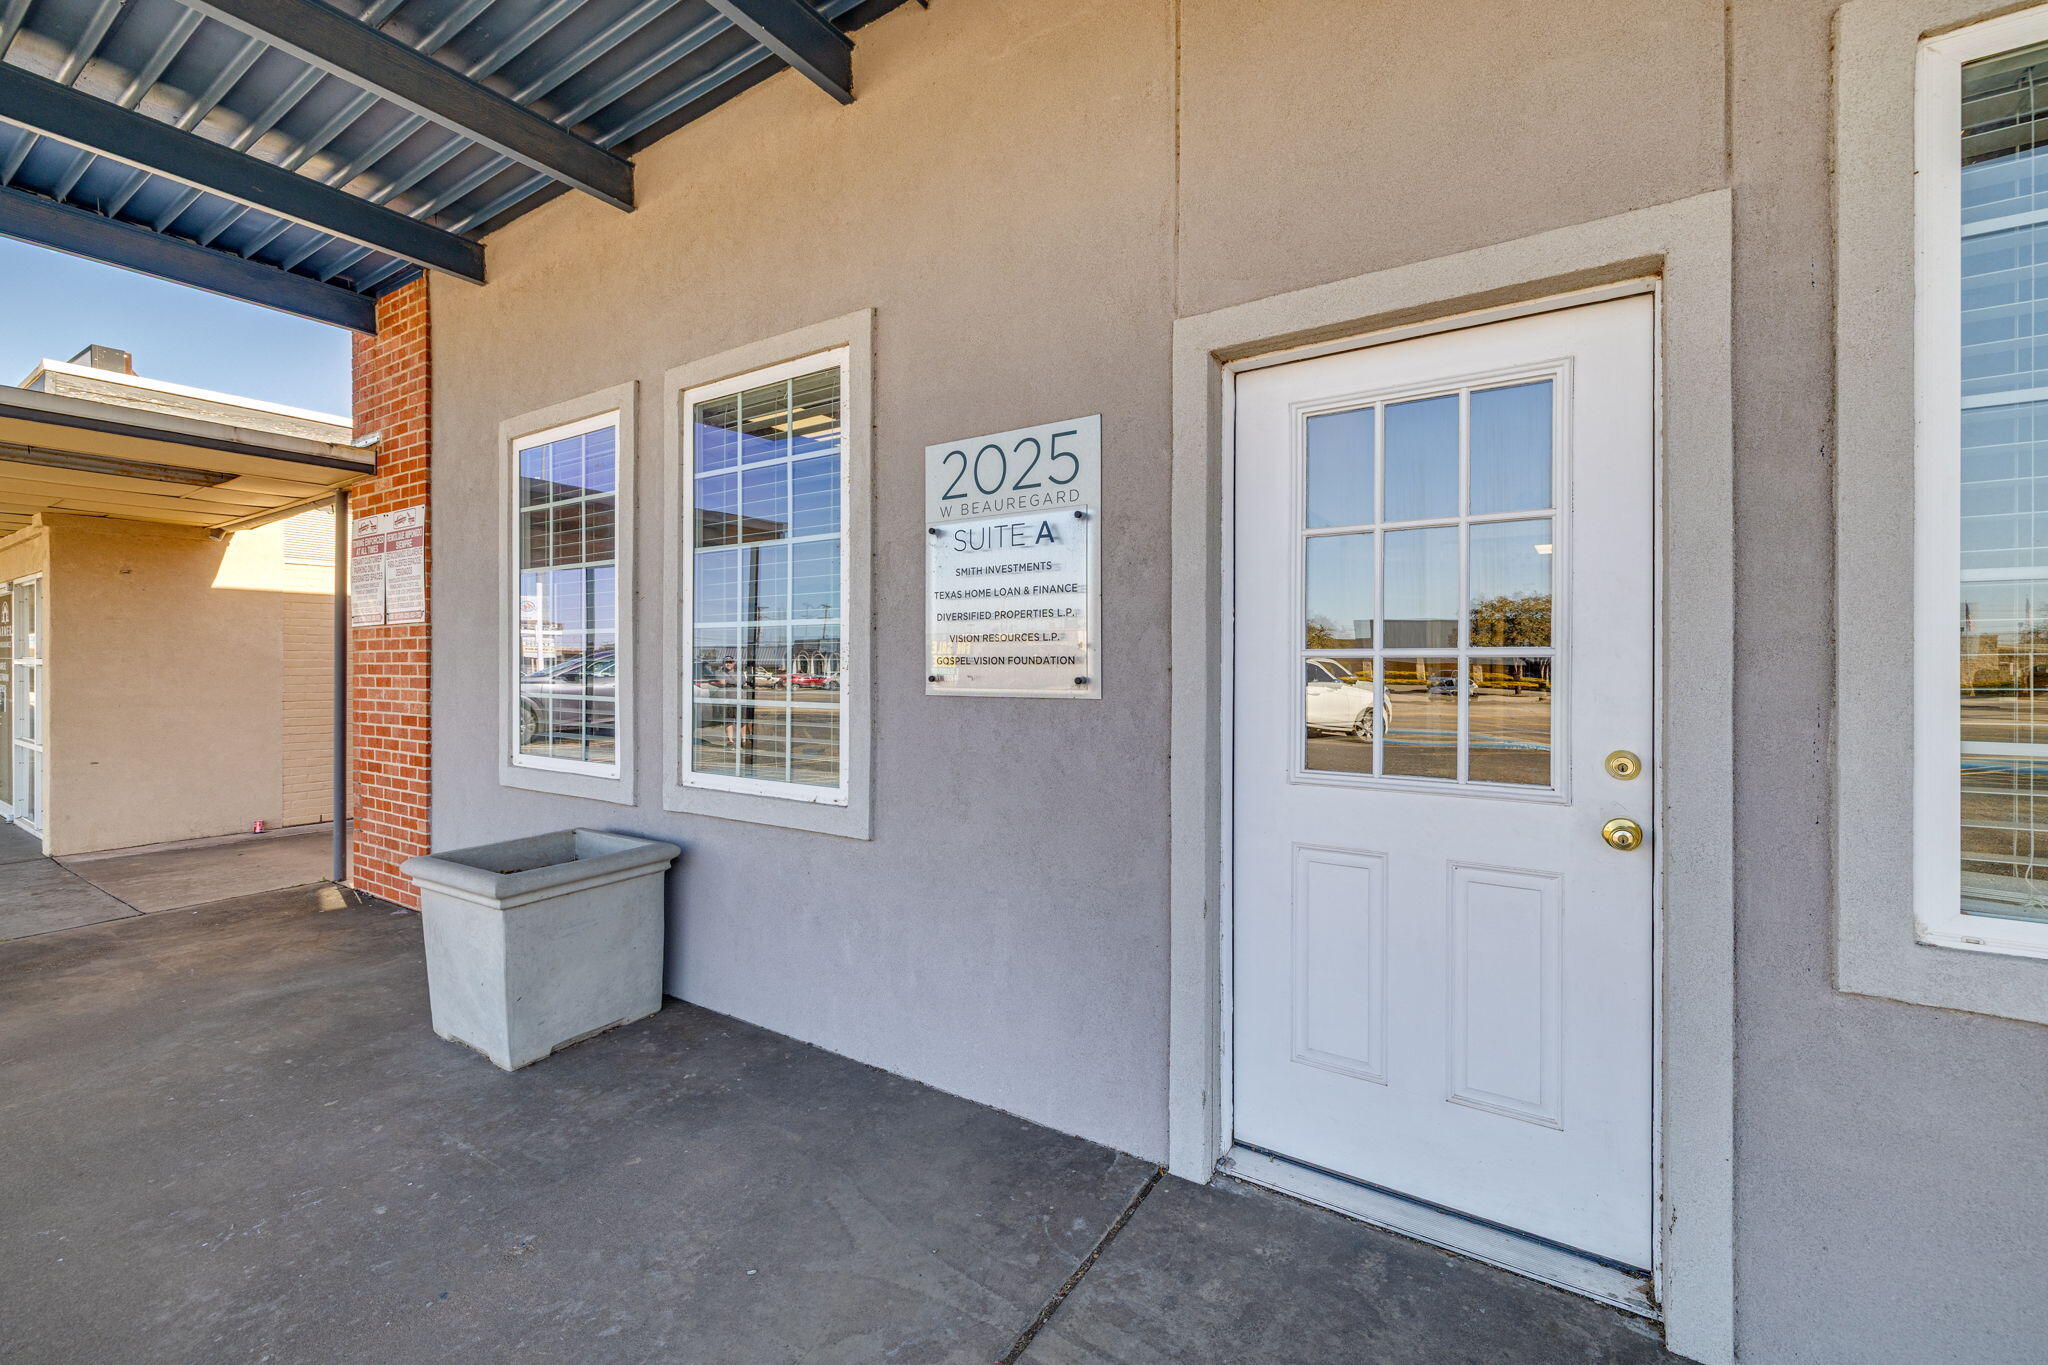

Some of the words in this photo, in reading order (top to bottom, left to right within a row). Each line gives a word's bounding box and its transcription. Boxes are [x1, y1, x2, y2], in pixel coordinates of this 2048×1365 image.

[942, 430, 1079, 500] 2025
[940, 506, 952, 518] W
[961, 489, 1080, 516] BEAUREGARD
[954, 523, 1025, 552] SUITE
[1035, 520, 1055, 544] A
[956, 567, 982, 576] SMITH
[985, 561, 1052, 574] INVESTMENTS
[934, 590, 962, 599] TEXAS
[965, 589, 991, 598] HOME
[994, 587, 1021, 596] LOAN
[1023, 586, 1030, 595] &
[1033, 583, 1078, 594] FINANCE
[937, 612, 992, 621] DIVERSIFIED
[994, 609, 1054, 620] PROPERTIES
[1057, 608, 1075, 617] L.P.
[950, 634, 980, 643] VISION
[982, 633, 1039, 643] RESOURCES
[1042, 633, 1060, 641] L.P.
[936, 656, 971, 666] GOSPEL
[974, 656, 1005, 665] VISION
[1007, 655, 1075, 665] FOUNDATION
